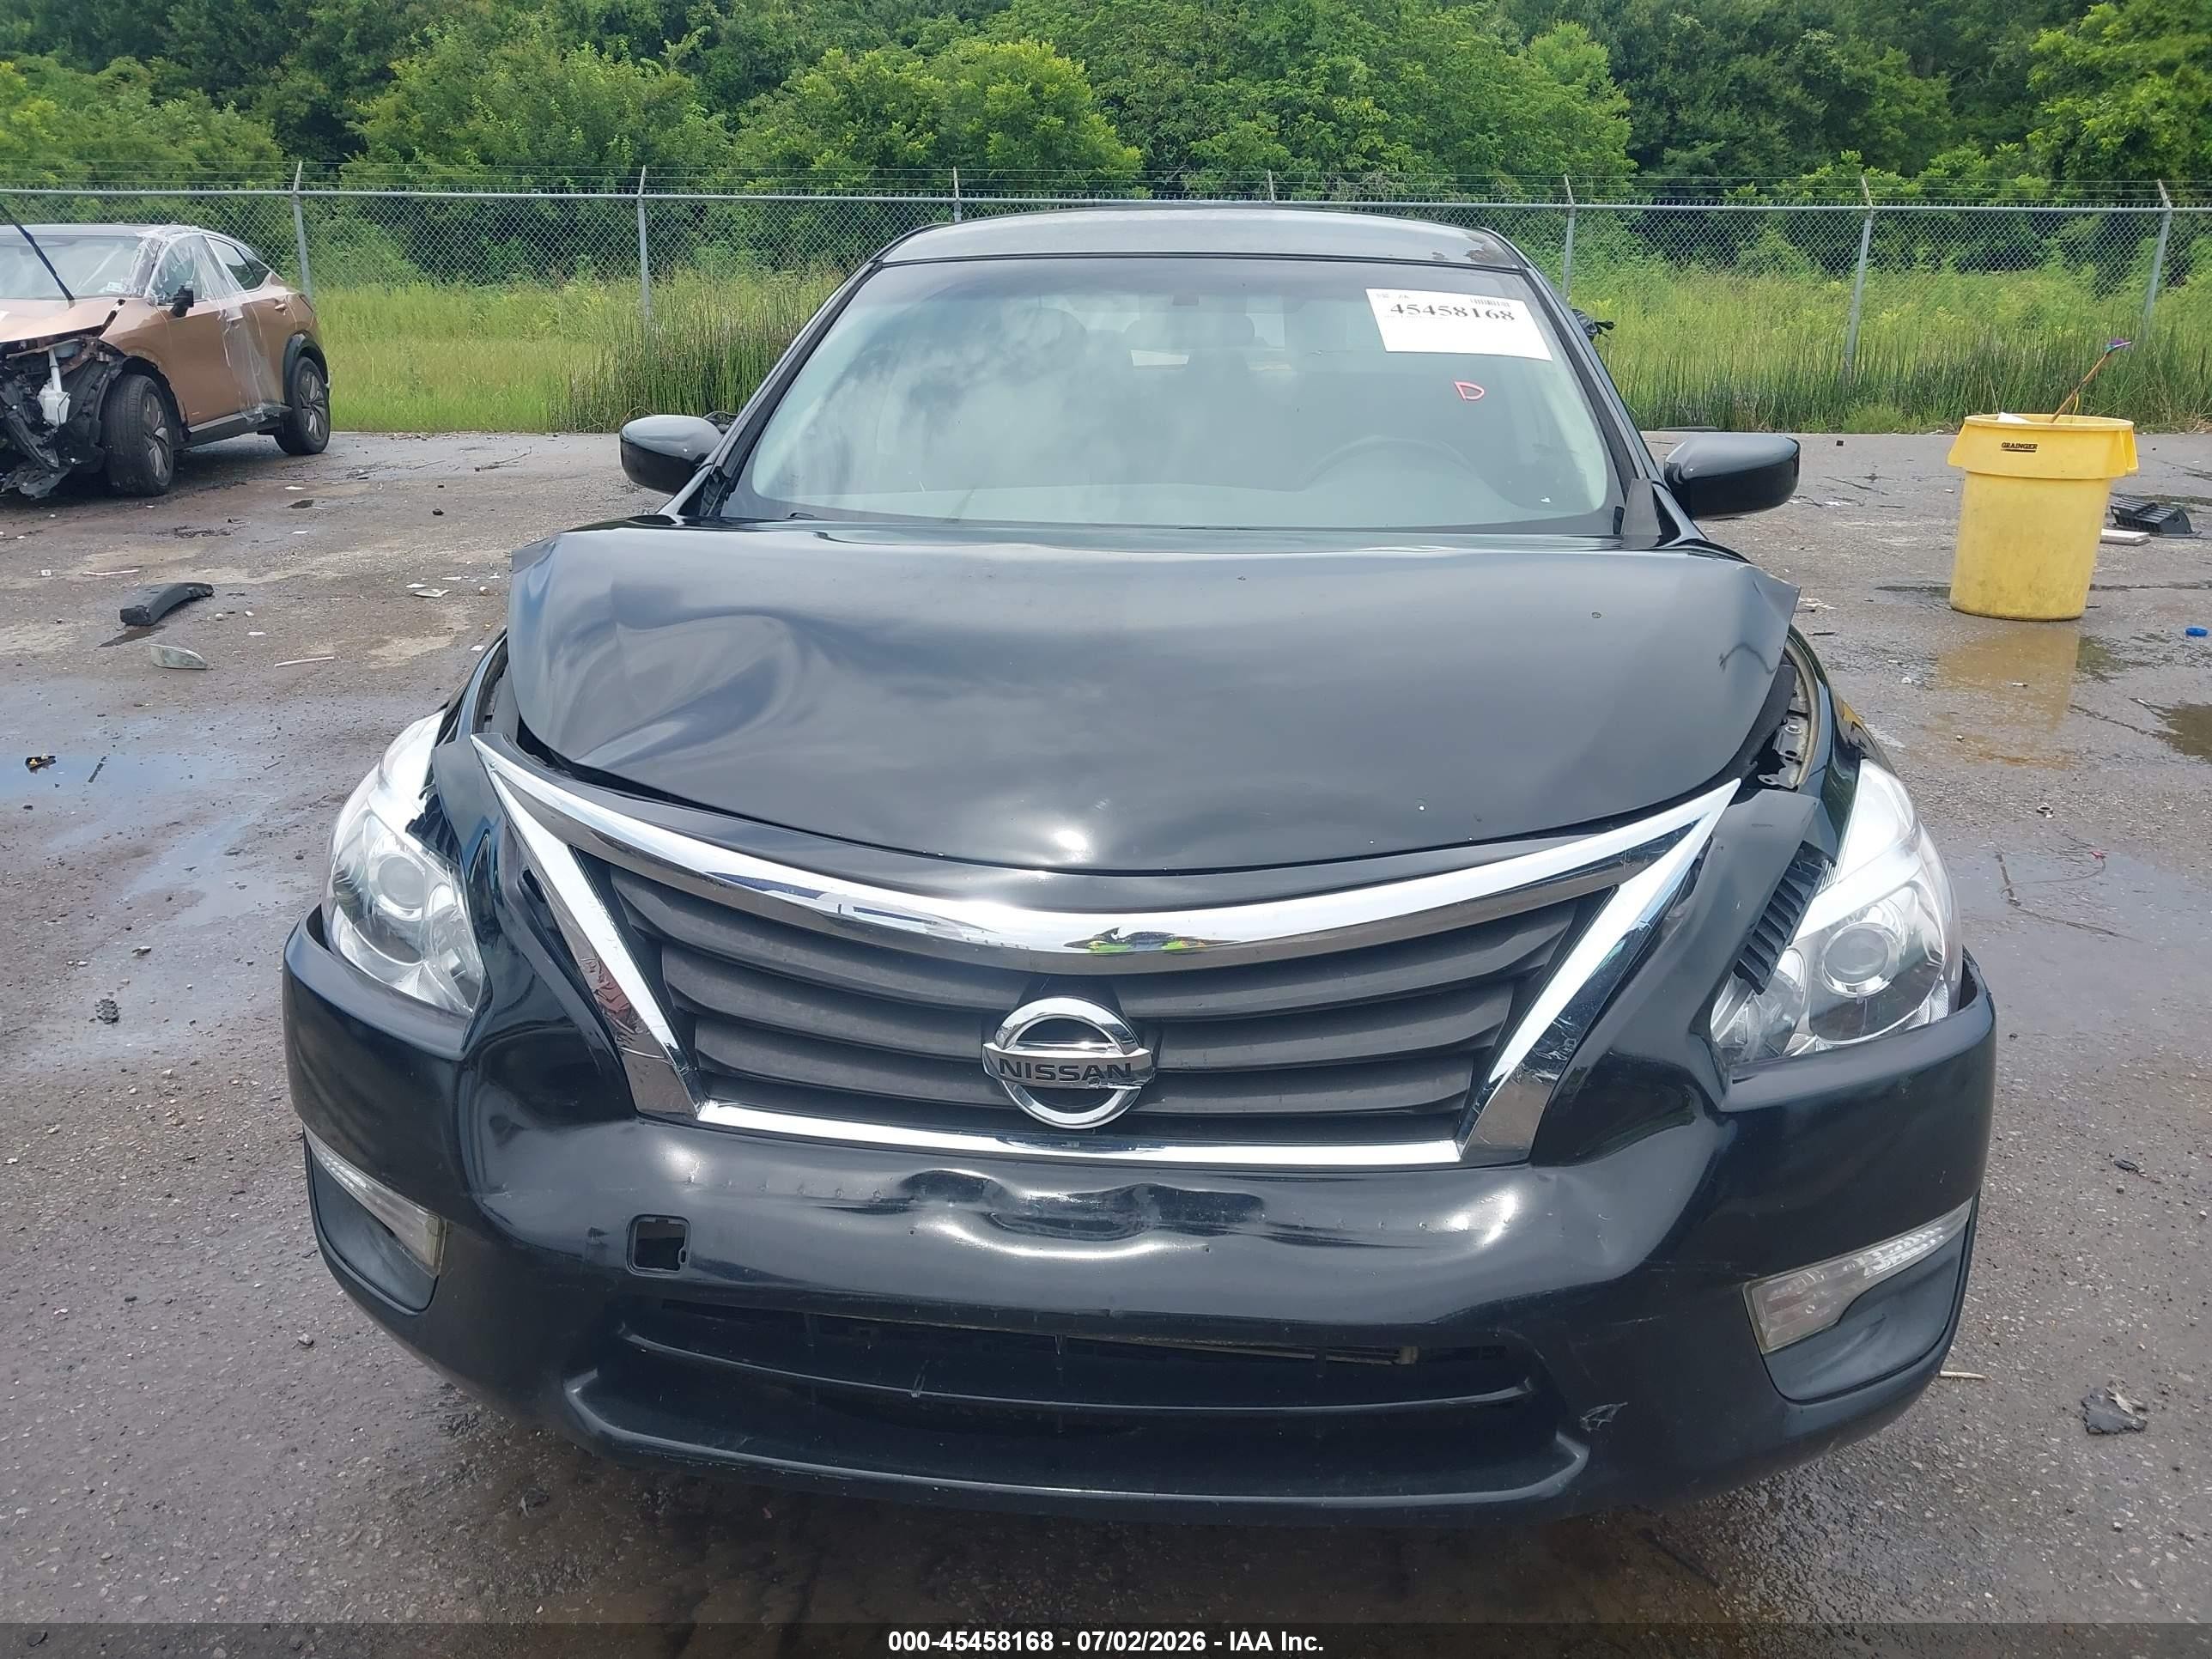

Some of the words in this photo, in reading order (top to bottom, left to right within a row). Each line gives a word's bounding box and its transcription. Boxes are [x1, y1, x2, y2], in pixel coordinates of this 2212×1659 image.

[1390, 303, 1516, 321] 45458168
[1455, 380, 1485, 400] D
[999, 1058, 1132, 1082] NISSAN
